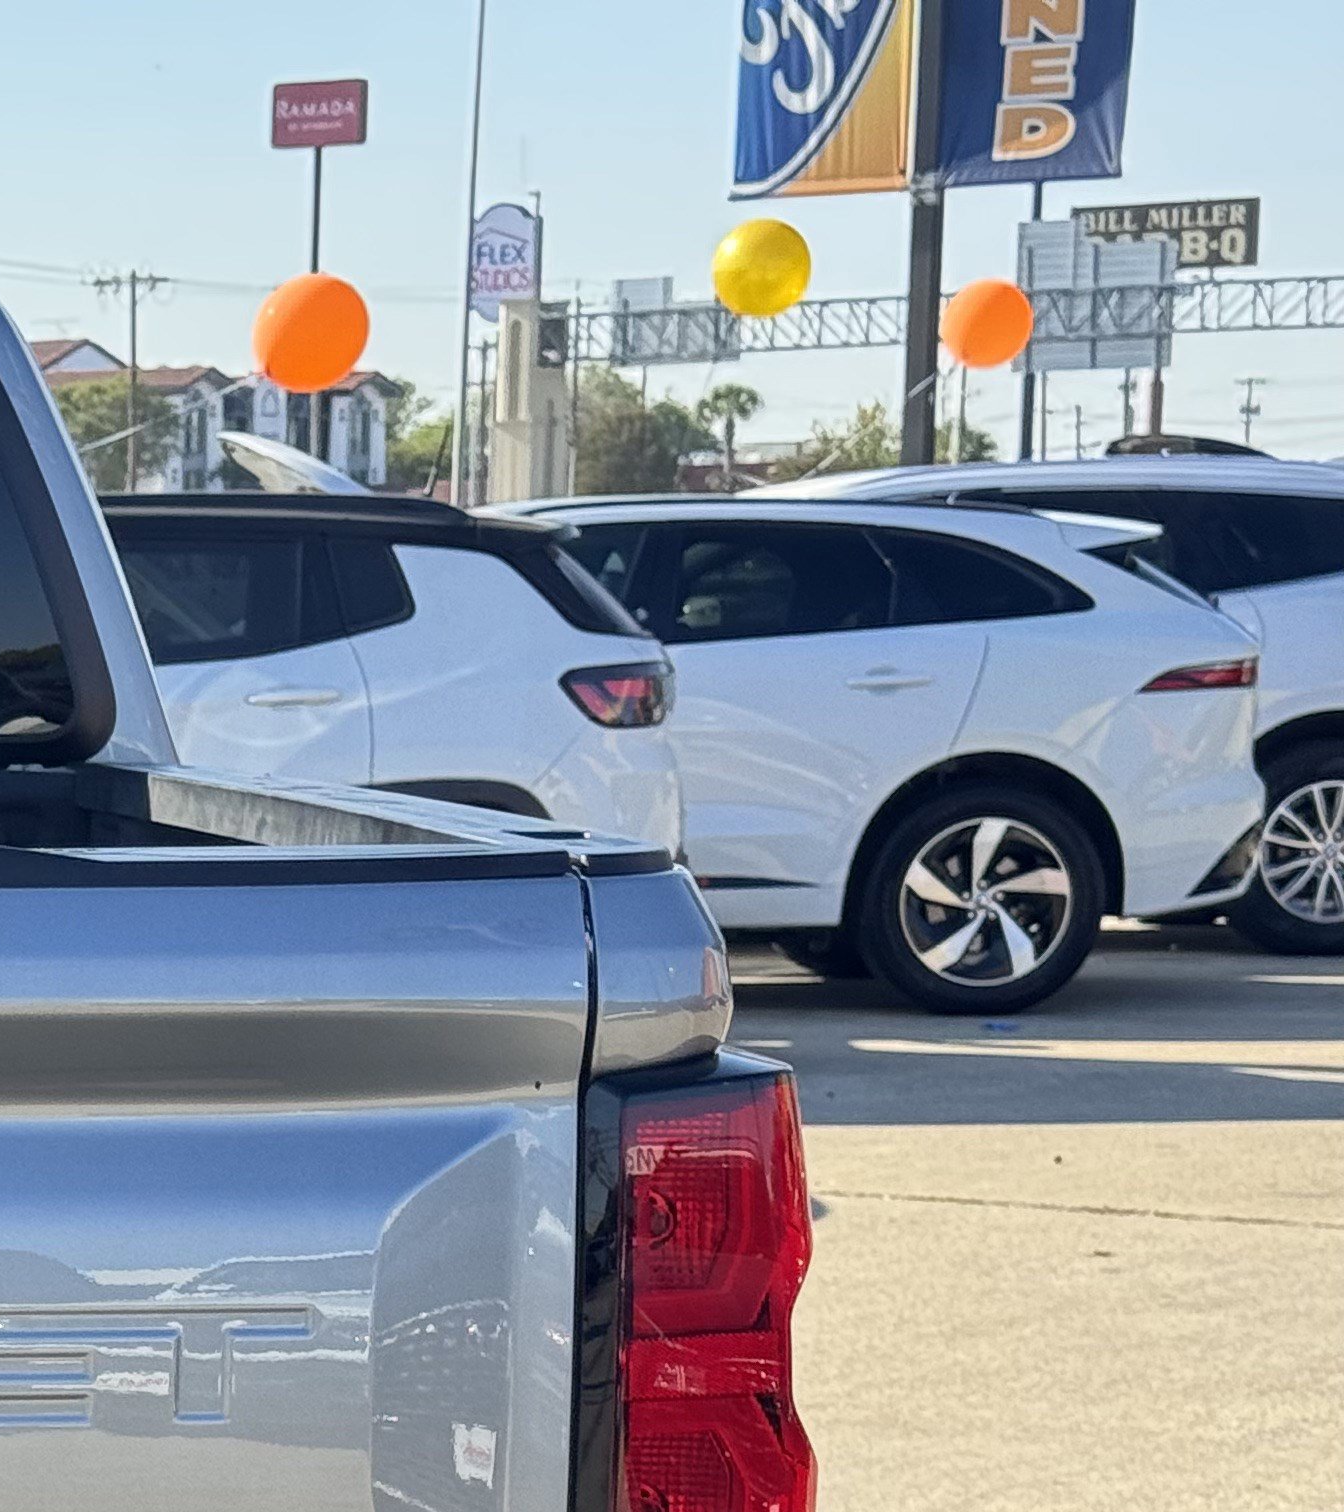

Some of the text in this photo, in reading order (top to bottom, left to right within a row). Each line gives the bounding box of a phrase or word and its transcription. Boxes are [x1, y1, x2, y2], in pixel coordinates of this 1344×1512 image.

[276, 98, 355, 119] RAMADA
[1146, 203, 1248, 230] MILLER
[476, 242, 527, 267] FLEX
